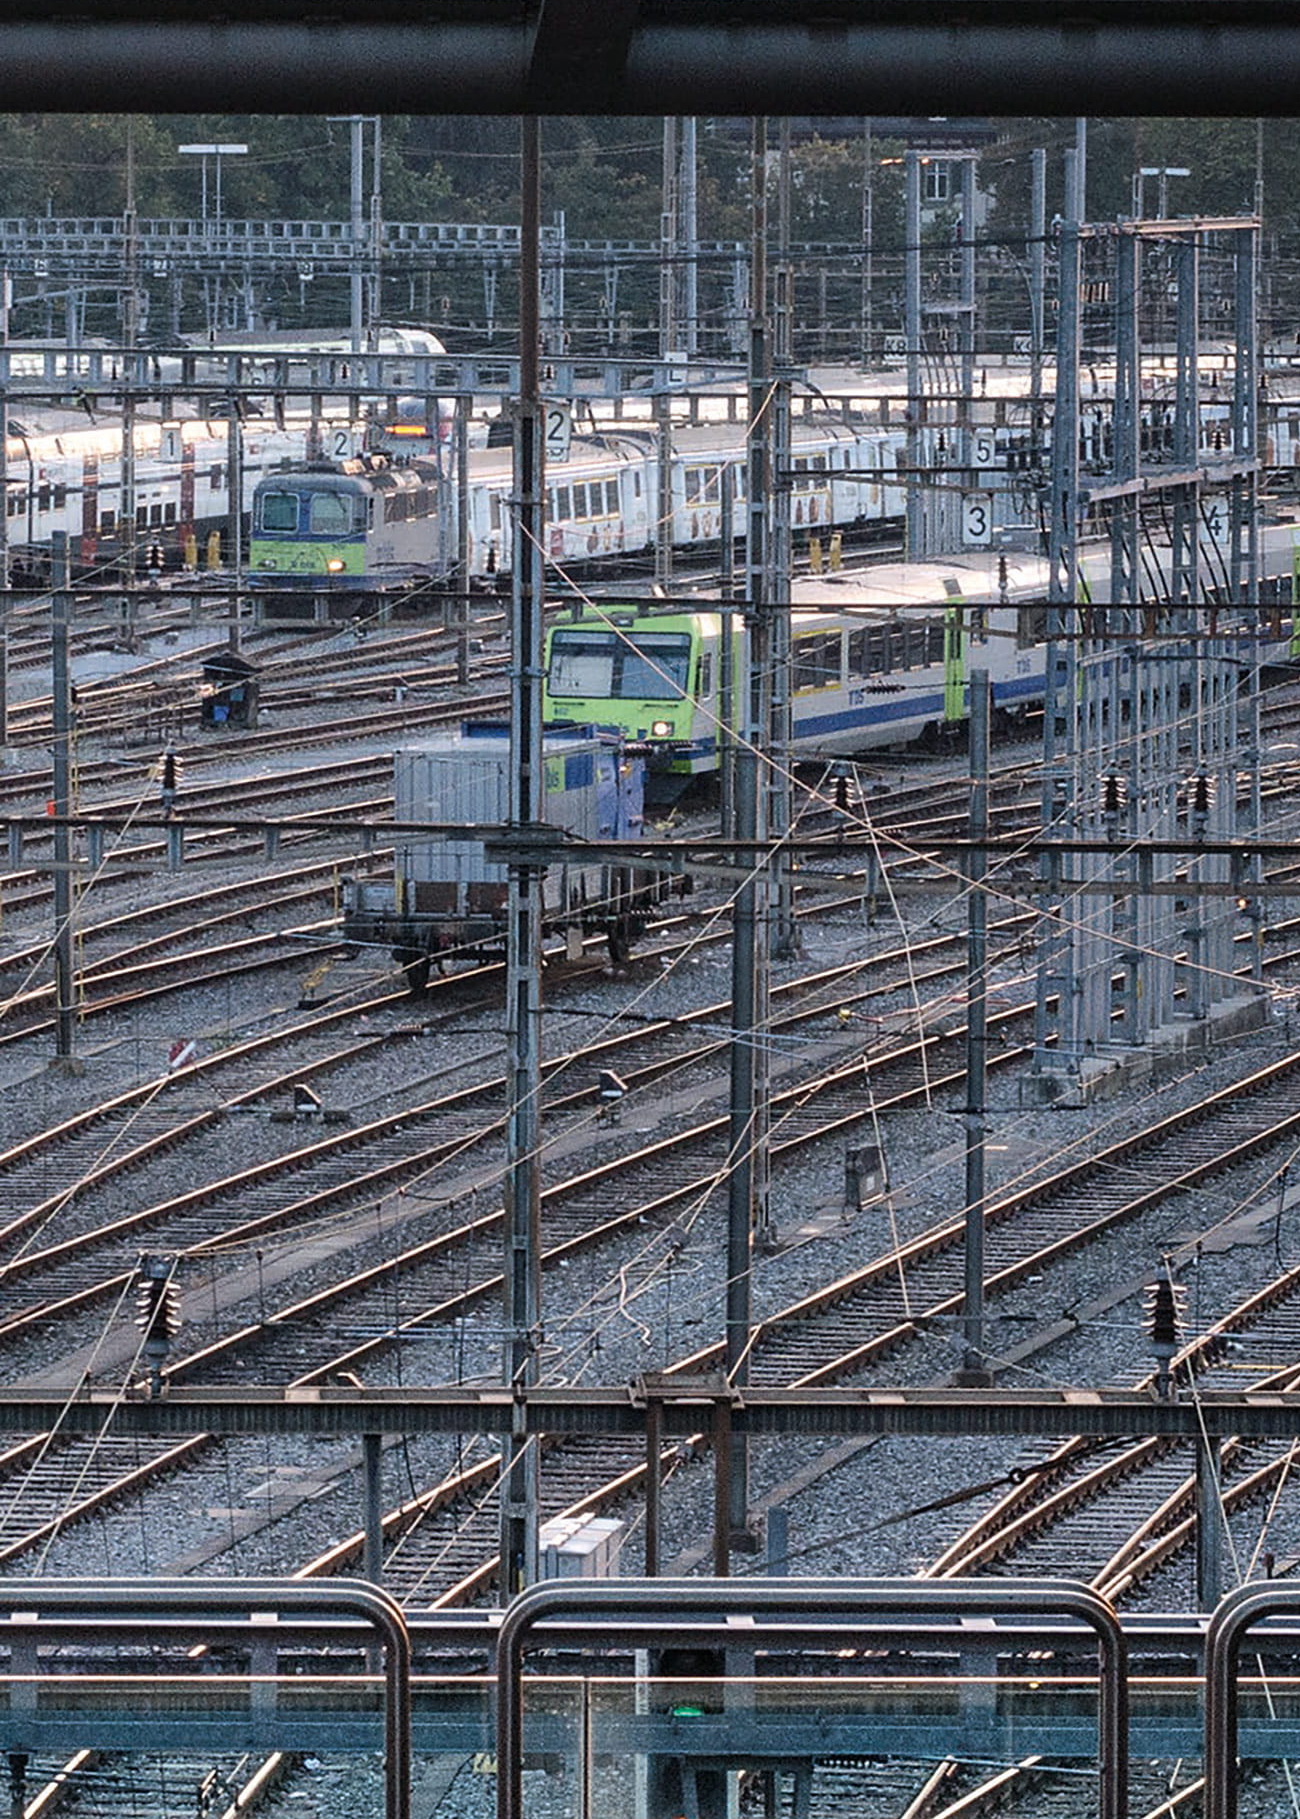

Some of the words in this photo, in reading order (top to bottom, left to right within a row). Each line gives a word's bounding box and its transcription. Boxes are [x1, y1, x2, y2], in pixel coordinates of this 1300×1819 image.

[547, 409, 564, 441] 2
[166, 431, 175, 457] 1
[334, 431, 348, 456] 2
[976, 438, 990, 463] 5
[967, 506, 987, 537] 3
